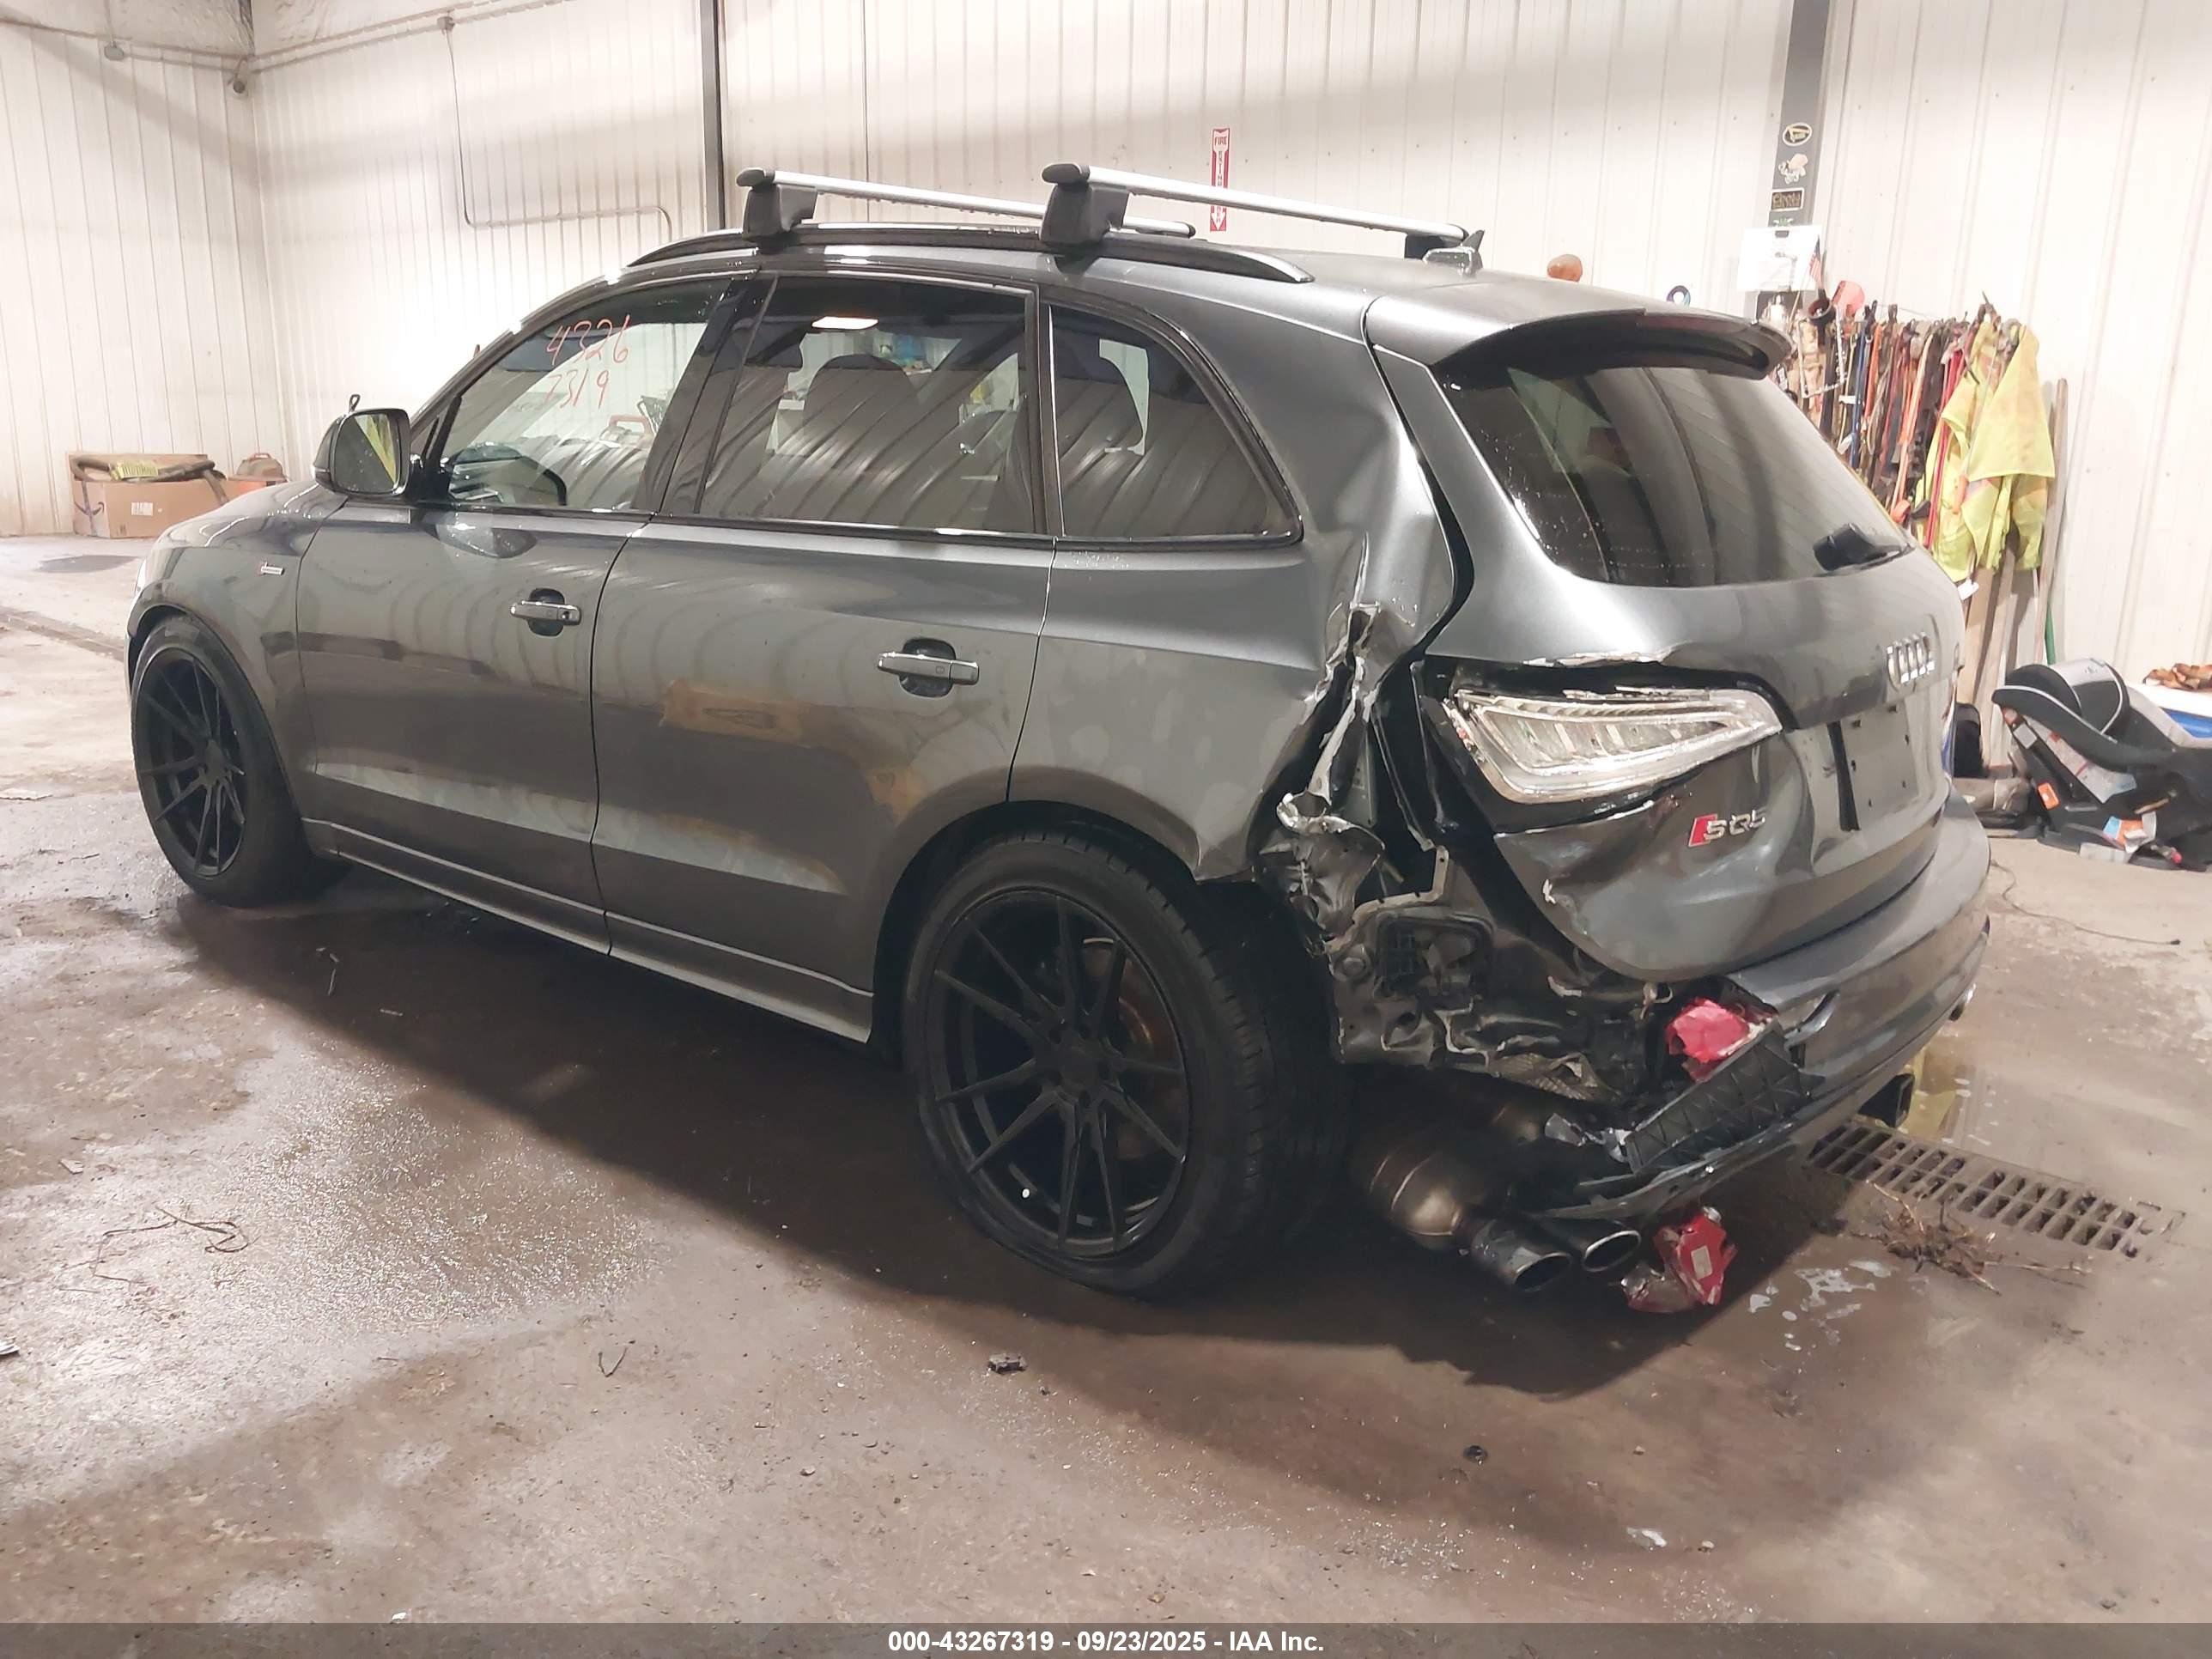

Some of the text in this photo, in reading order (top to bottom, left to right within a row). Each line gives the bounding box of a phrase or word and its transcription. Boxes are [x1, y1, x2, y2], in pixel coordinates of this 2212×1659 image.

[1214, 137, 1227, 145] FIRE
[546, 313, 631, 366] 4326
[1703, 807, 1766, 841] SQ5
